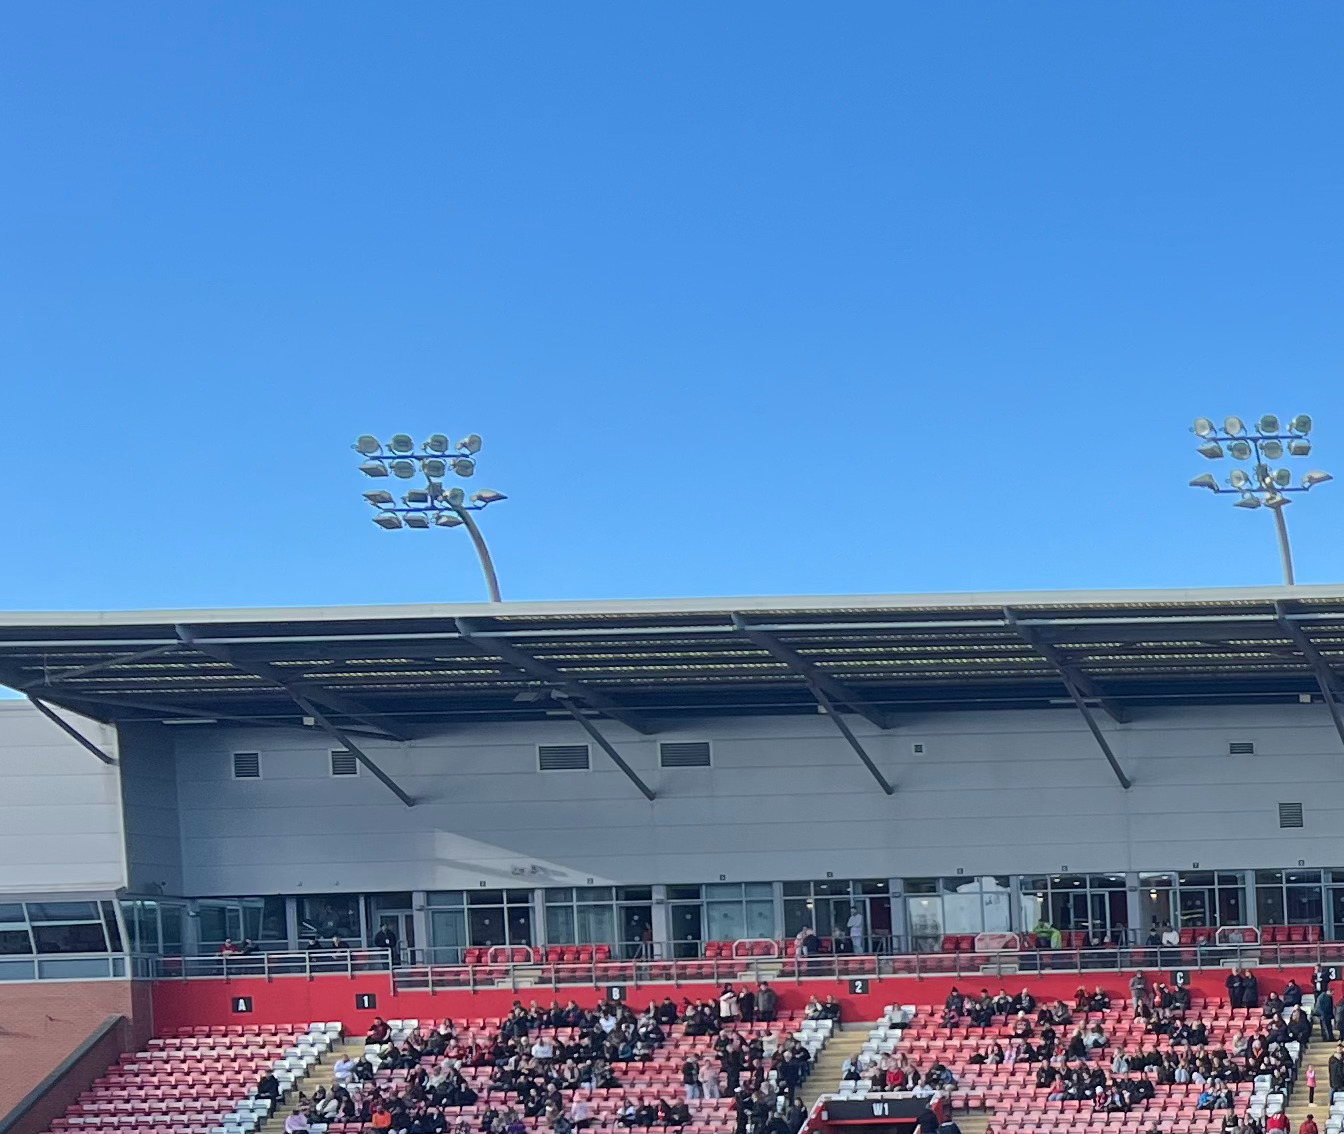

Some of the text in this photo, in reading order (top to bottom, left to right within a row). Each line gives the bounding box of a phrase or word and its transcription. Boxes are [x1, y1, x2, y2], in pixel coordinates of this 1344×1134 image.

[1176, 972, 1184, 984] C
[1329, 967, 1336, 980] 3
[855, 980, 863, 993] 2
[238, 999, 247, 1011] A
[362, 995, 369, 1007] 1
[872, 1103, 889, 1116] W1
